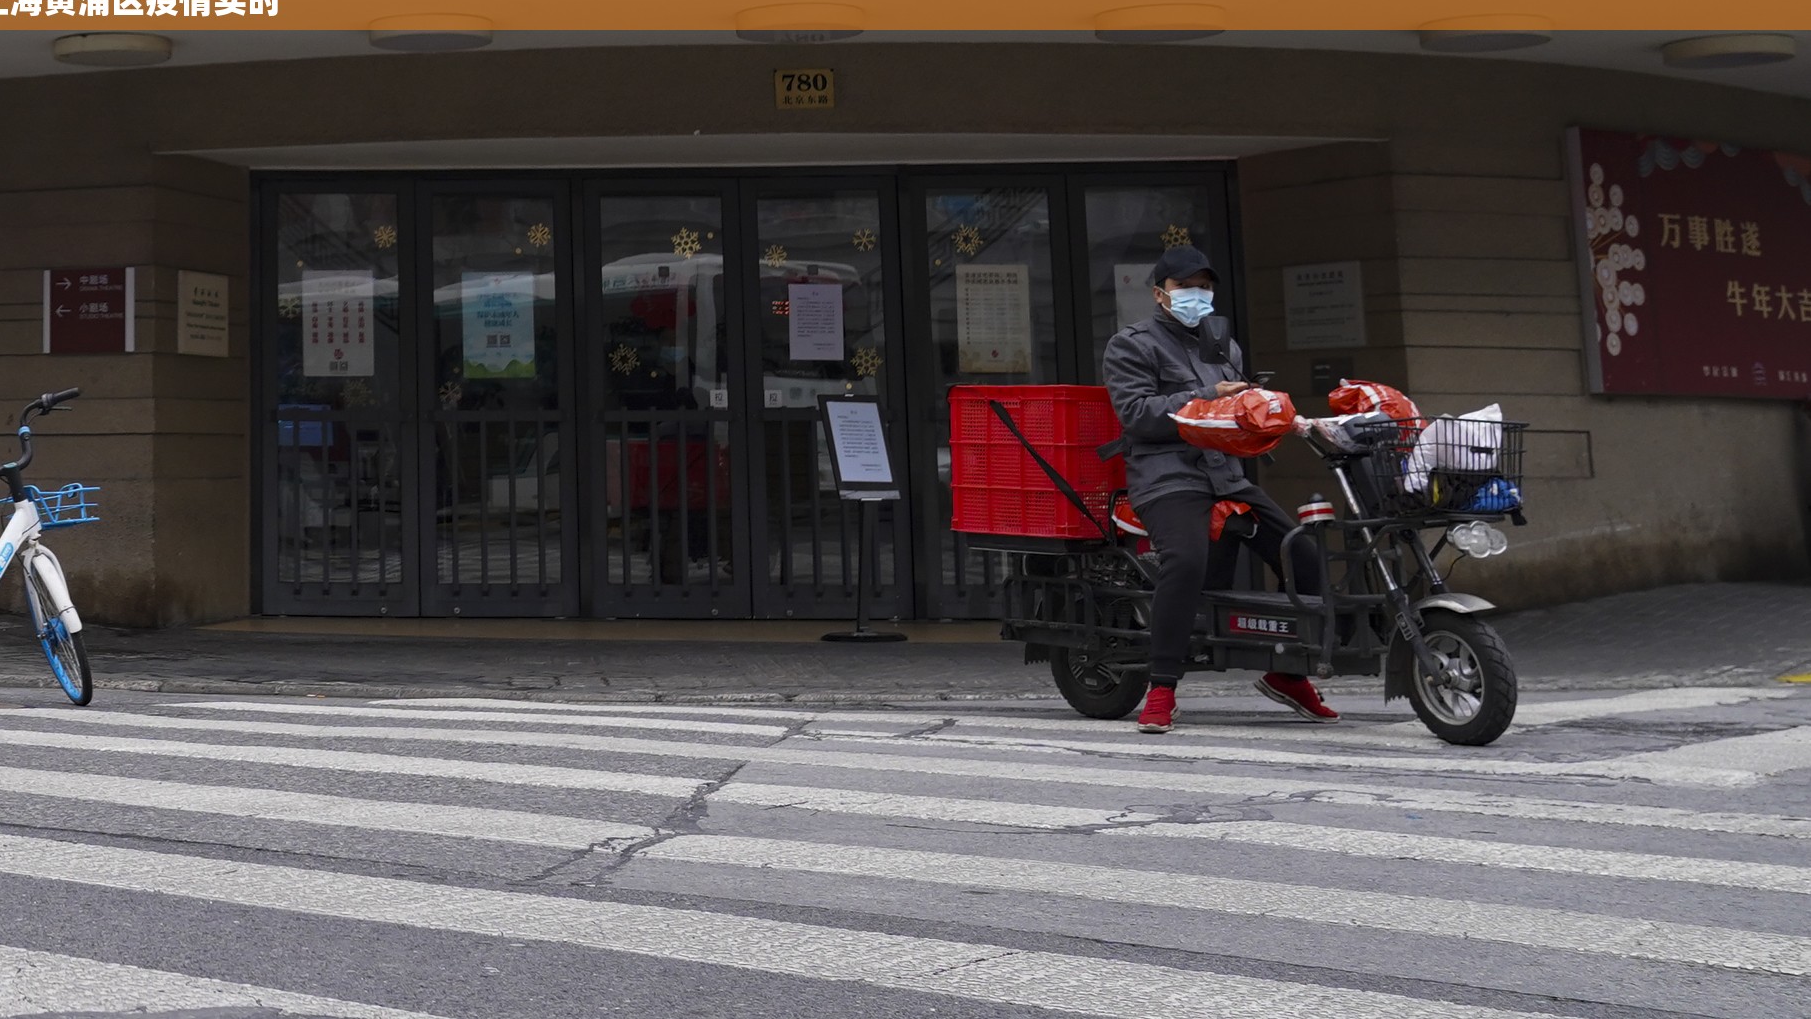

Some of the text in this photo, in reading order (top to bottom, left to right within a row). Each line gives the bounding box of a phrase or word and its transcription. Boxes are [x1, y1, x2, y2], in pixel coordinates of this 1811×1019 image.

[782, 73, 828, 92] 780
[1726, 279, 1811, 322] 牛年大吉
